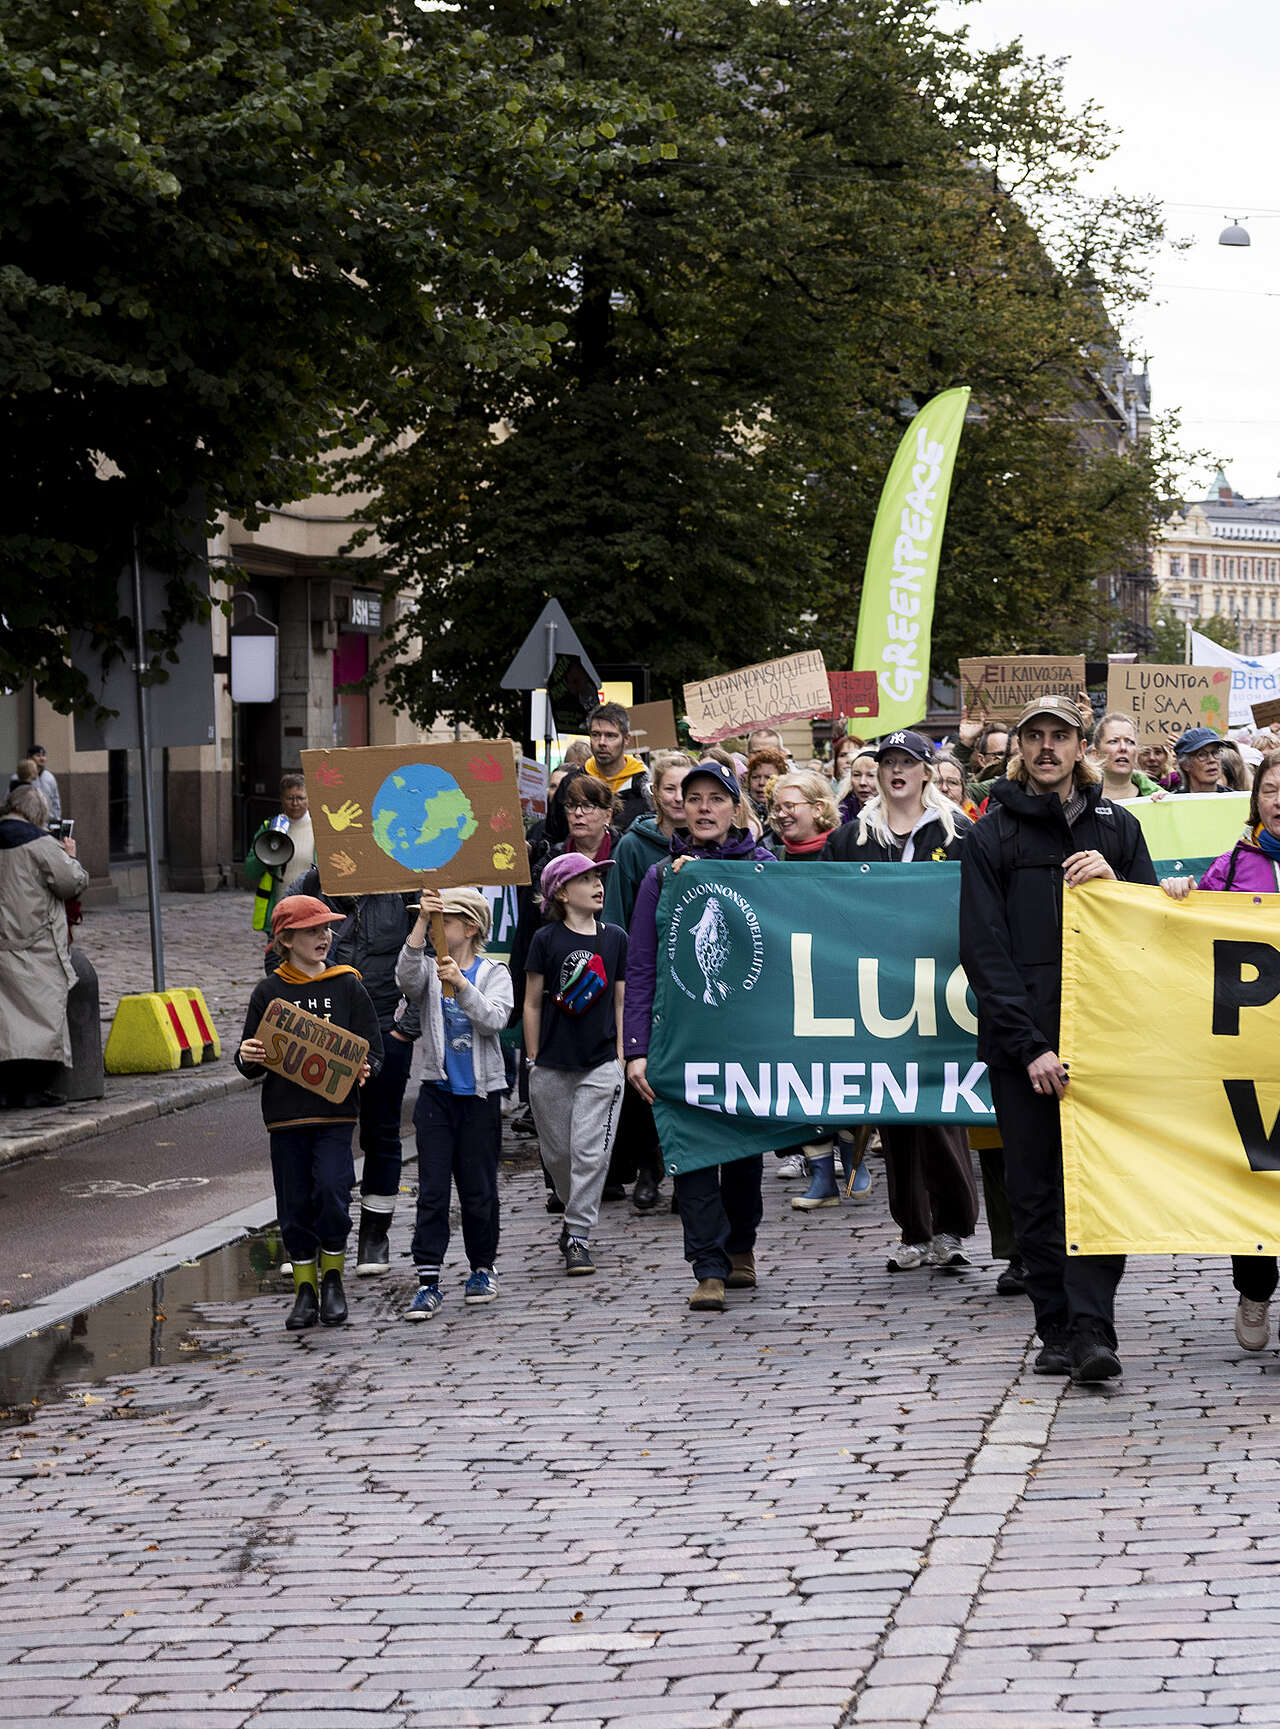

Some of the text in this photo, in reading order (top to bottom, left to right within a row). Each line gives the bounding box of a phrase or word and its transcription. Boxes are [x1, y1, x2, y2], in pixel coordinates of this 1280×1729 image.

[879, 427, 944, 702] GREENPEACE
[984, 664, 1073, 682] EI KAIVOSTA
[1126, 671, 1209, 690] LUONTOA
[702, 695, 737, 720] ALUE
[770, 678, 798, 700] OLE
[1154, 695, 1193, 714] SAA
[265, 1002, 366, 1065] PELASTETAAN
[264, 1032, 353, 1095] SUOT
[684, 1062, 919, 1116] ENNEN
